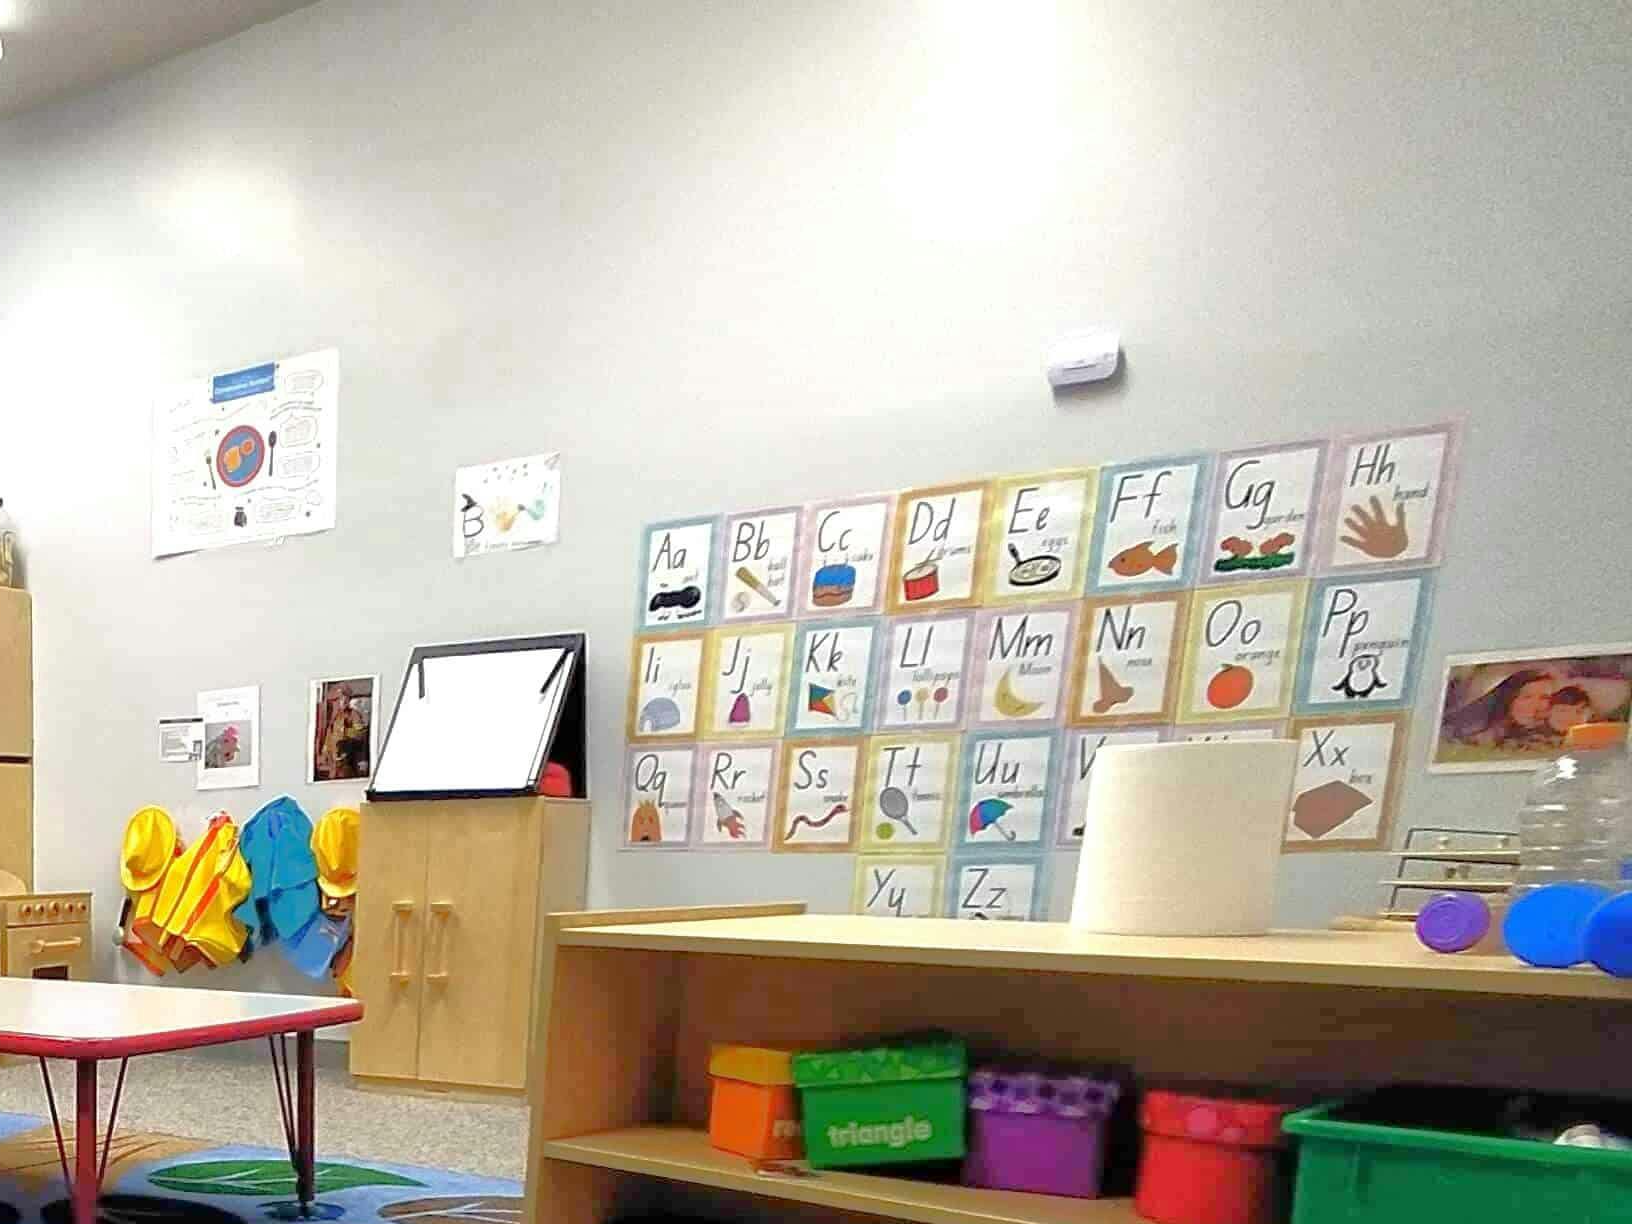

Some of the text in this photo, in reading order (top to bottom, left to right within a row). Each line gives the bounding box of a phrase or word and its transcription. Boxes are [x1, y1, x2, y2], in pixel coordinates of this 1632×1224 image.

[1350, 443, 1396, 487] Hh
[1008, 487, 1051, 534] Ee
[1110, 470, 1172, 522] Ff
[1225, 460, 1275, 530] Gg
[732, 521, 770, 562] Bb
[818, 511, 852, 552] Cc
[908, 497, 956, 544] Dd
[653, 533, 687, 571] Aa
[989, 615, 1054, 661] Mm
[1096, 607, 1146, 653] Nn
[1205, 599, 1262, 648] Oo
[1322, 588, 1370, 659] Pp
[645, 647, 662, 684] Ii
[722, 637, 752, 694] Jj
[805, 632, 843, 673] Kk
[898, 625, 934, 668] Ll
[883, 747, 922, 788] Tt
[974, 742, 1021, 785] Uu
[1080, 736, 1107, 780] V
[1303, 729, 1350, 767] Xx
[635, 753, 667, 808] Qq
[710, 752, 746, 790] Rr
[793, 750, 829, 790] Ss
[867, 868, 906, 918] Yy
[961, 867, 1008, 909] Zz
[827, 1114, 934, 1148] triangle
